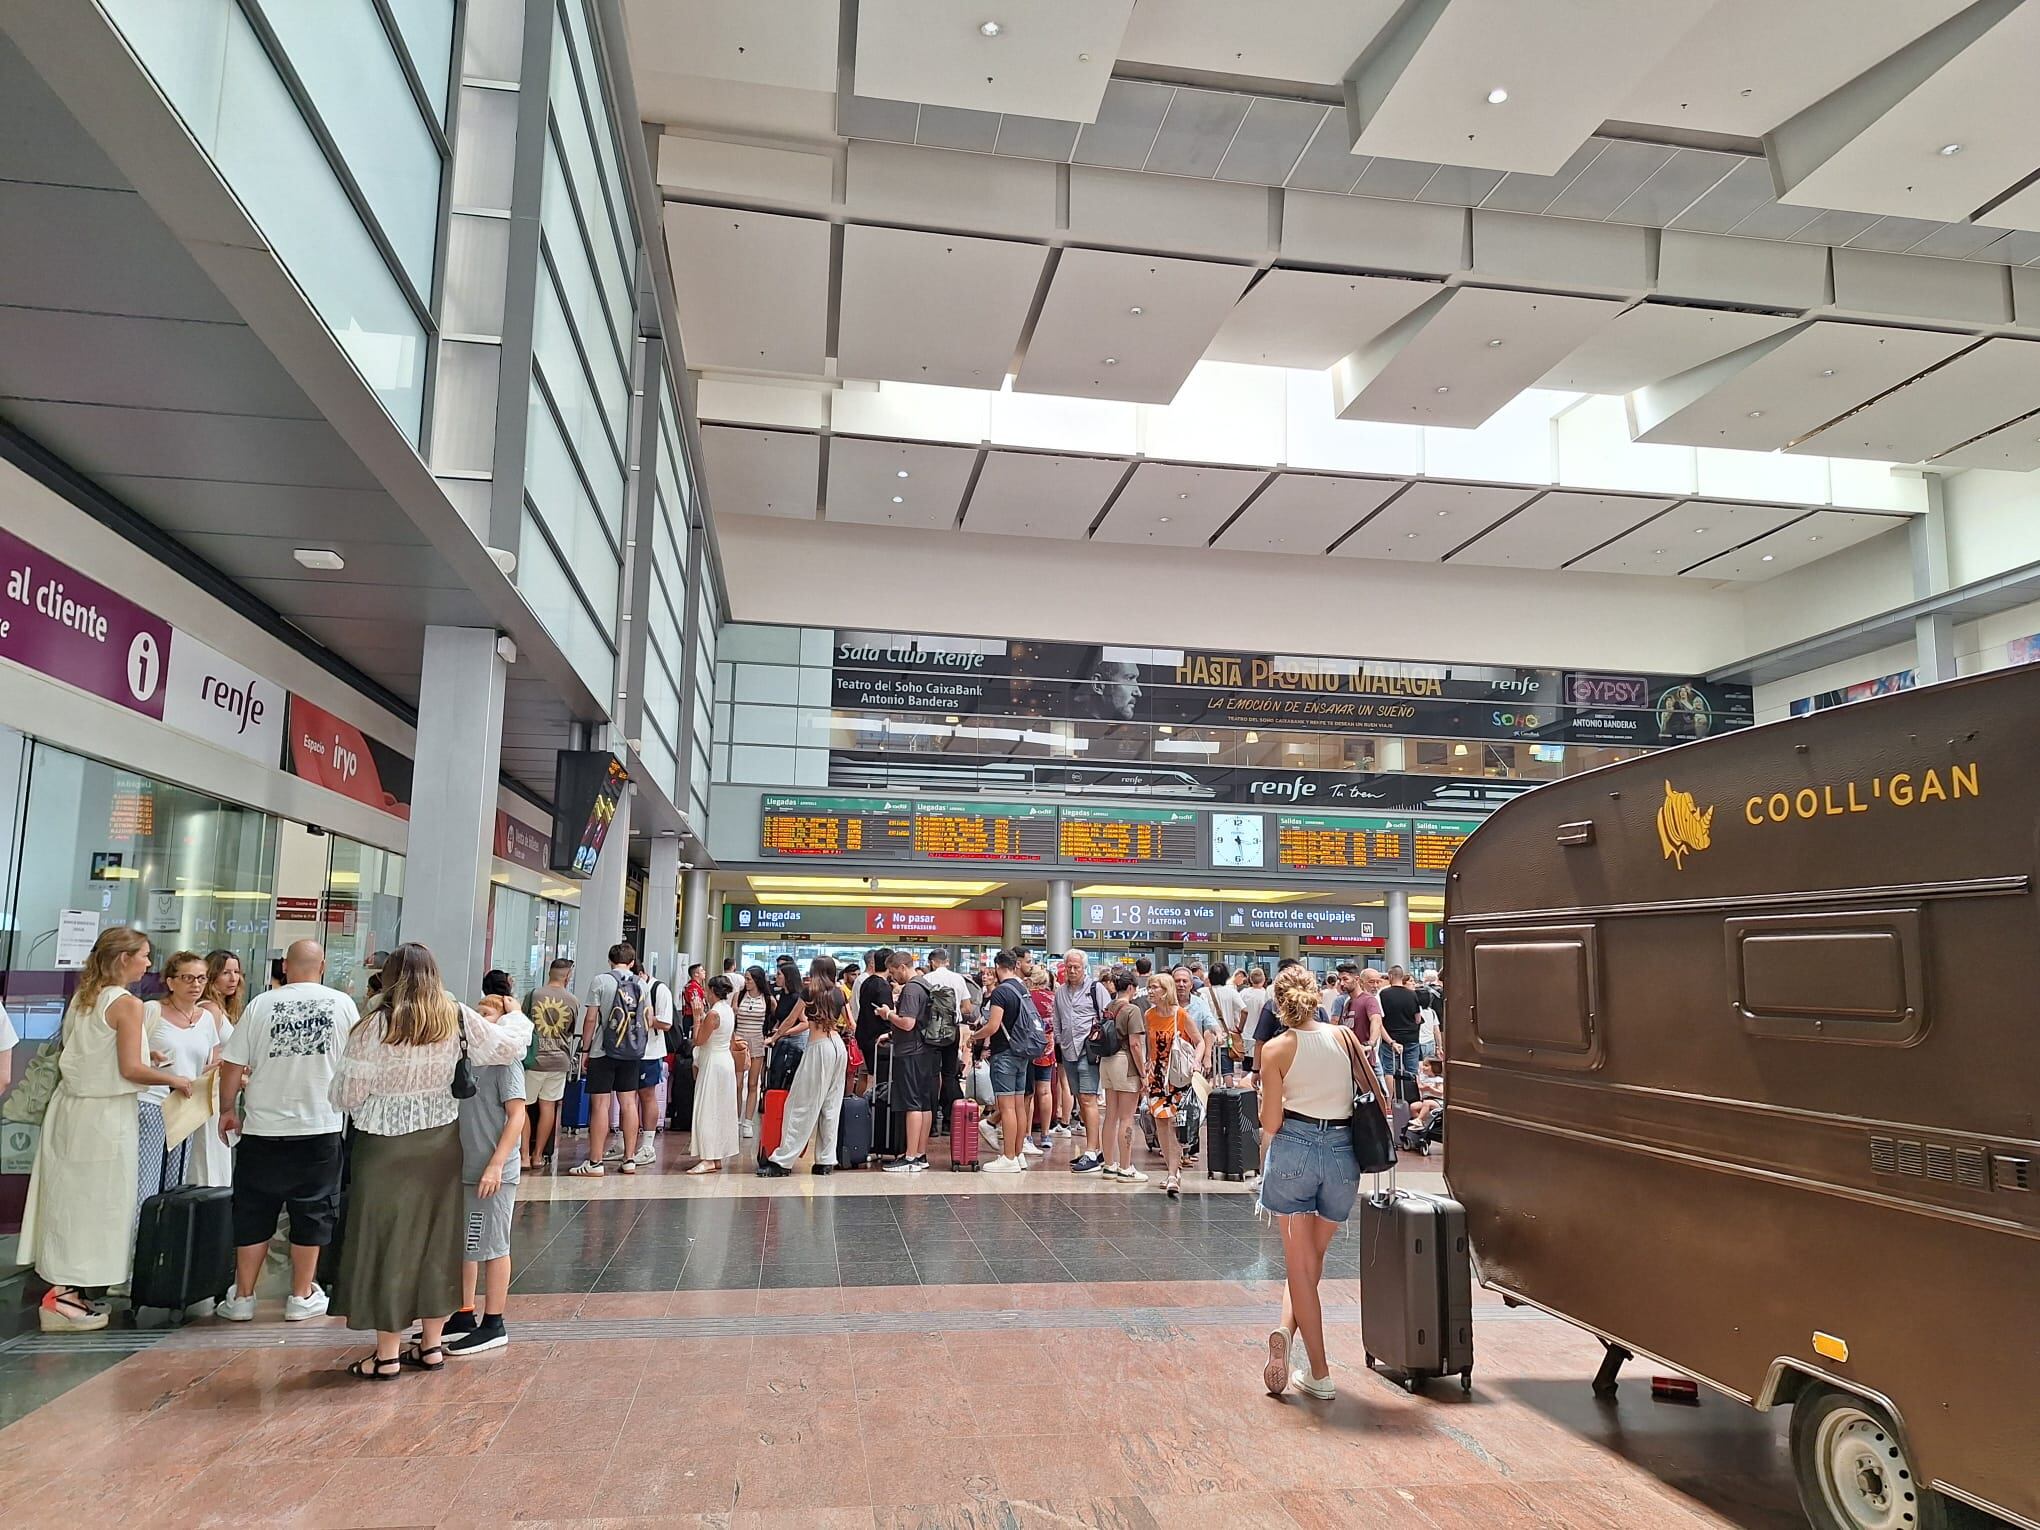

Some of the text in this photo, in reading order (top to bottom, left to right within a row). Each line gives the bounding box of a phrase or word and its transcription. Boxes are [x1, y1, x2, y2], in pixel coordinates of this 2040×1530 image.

[7, 566, 108, 643] al cliente
[838, 643, 985, 671] Sala Club Renfe
[836, 678, 983, 696] Teatro del Soho CaixaBank
[1491, 676, 1540, 695] renfe
[201, 675, 264, 734] renfe
[860, 693, 959, 708] Antonio Banderas
[1207, 696, 1416, 718] LA EMOCIÓN DE ENSAYAR UN SUEÑO
[1492, 711, 1539, 729] SOHO
[1572, 718, 1637, 729] ANTONIO BANDERAS
[303, 733, 358, 783] Espacio iryo
[1121, 775, 1143, 785] renfe
[1251, 776, 1317, 801] renfe
[1329, 783, 1387, 800] Tu tren
[766, 797, 797, 806] Llegadas
[917, 803, 946, 812] Llegadas
[1062, 808, 1090, 818] Llegadas
[1233, 819, 1243, 827] 12
[1280, 817, 1302, 825] Salidas
[1416, 822, 1438, 830] Salidas
[1217, 836, 1224, 844] 9
[1252, 837, 1259, 845] 3
[1234, 855, 1241, 863] 6
[758, 910, 801, 921] Llegadas
[893, 912, 935, 924] No pasar
[1112, 905, 1214, 924] 1-8 Acceso a vías
[1251, 908, 1356, 923] Control de equipajes
[1147, 918, 1187, 926] PLATFORMS
[1251, 921, 1284, 929] LUGGAGE
[466, 1209, 484, 1254] PUMA
